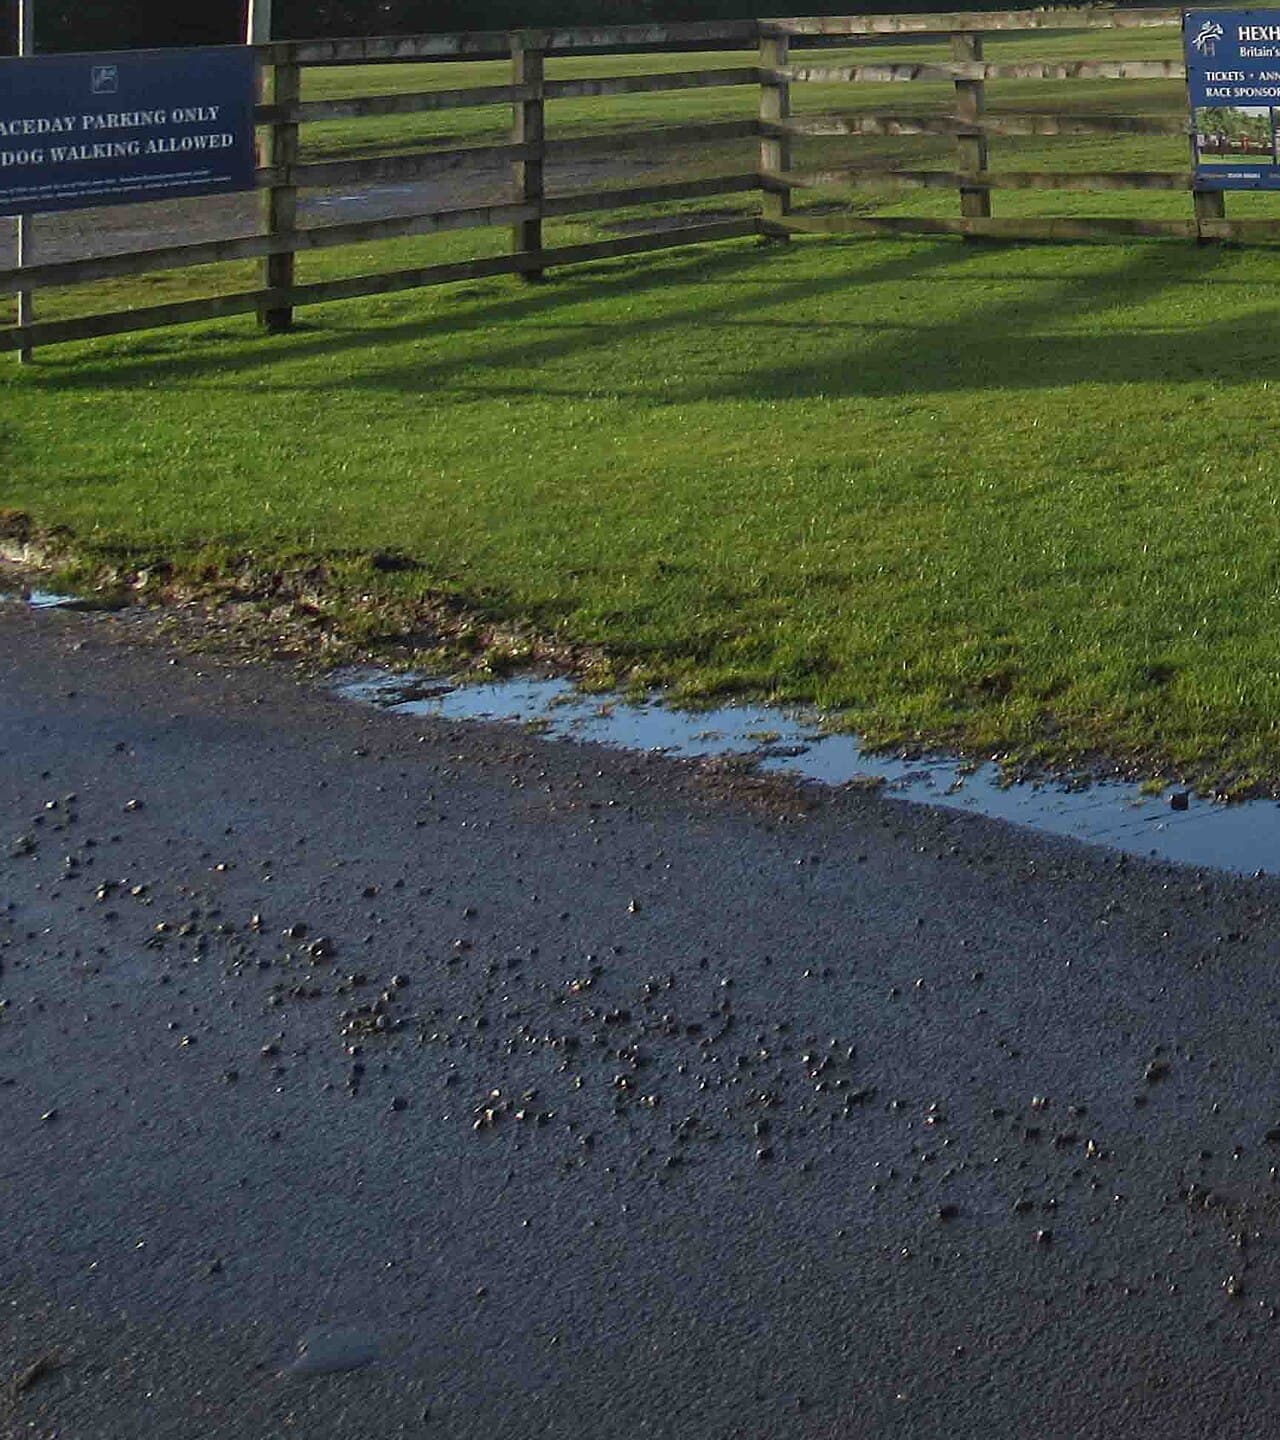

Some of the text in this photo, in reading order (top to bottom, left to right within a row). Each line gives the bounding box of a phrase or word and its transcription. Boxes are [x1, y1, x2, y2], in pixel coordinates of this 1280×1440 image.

[1240, 45, 1280, 58] Britain's
[1205, 71, 1246, 81] TICKETS
[1206, 87, 1232, 97] RACE
[82, 110, 166, 130] PARKING
[172, 105, 221, 124] ONLY
[1, 133, 234, 167] DOG WALKING ALLOWED
